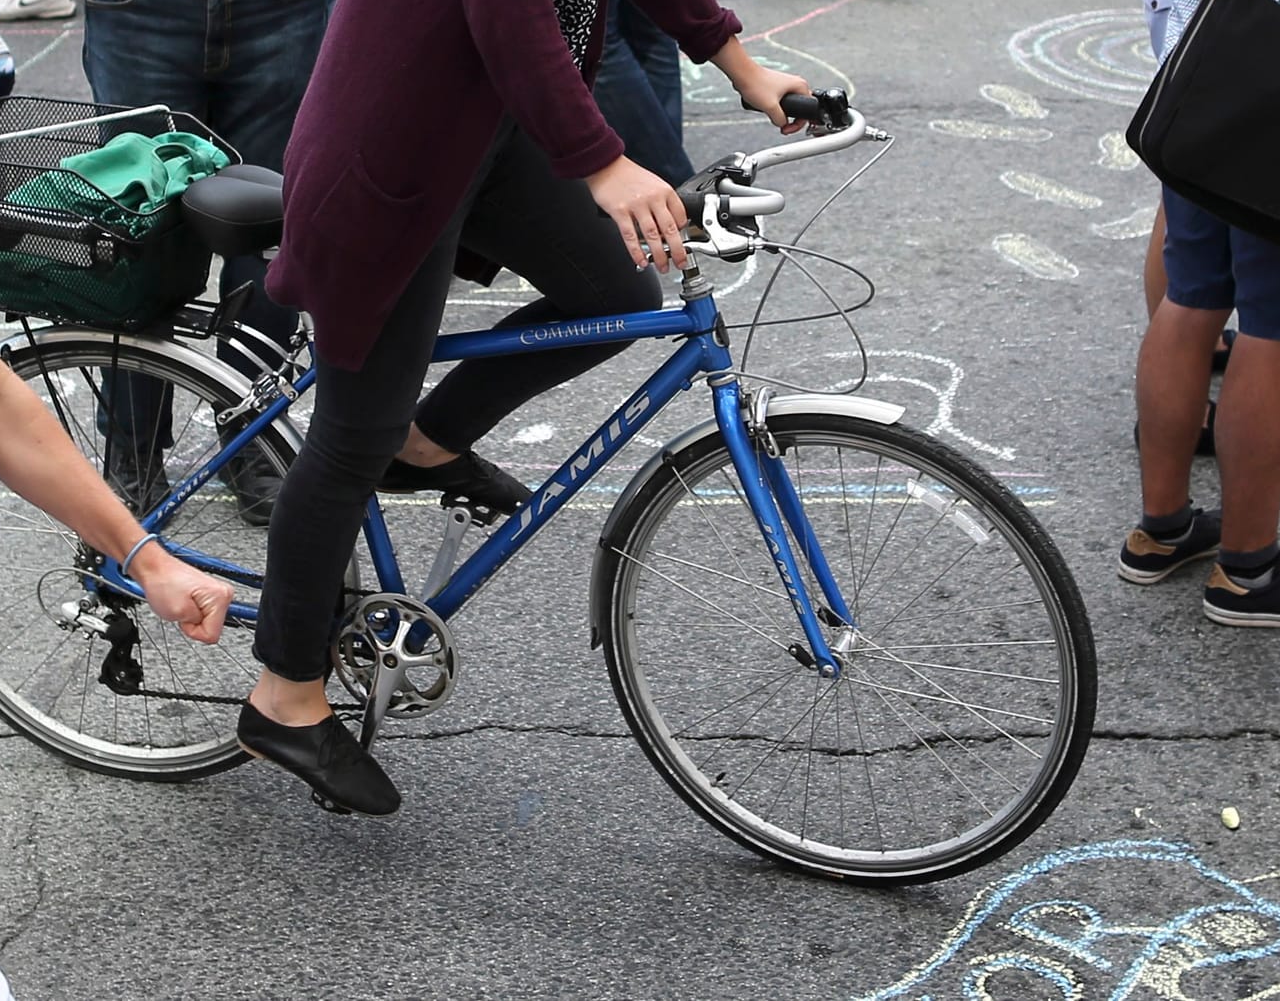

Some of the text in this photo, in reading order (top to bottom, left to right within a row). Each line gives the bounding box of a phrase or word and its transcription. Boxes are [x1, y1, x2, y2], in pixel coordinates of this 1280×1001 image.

[519, 319, 626, 346] COMMUTER
[510, 390, 651, 542] JAMIS
[153, 469, 210, 524] JAMIS
